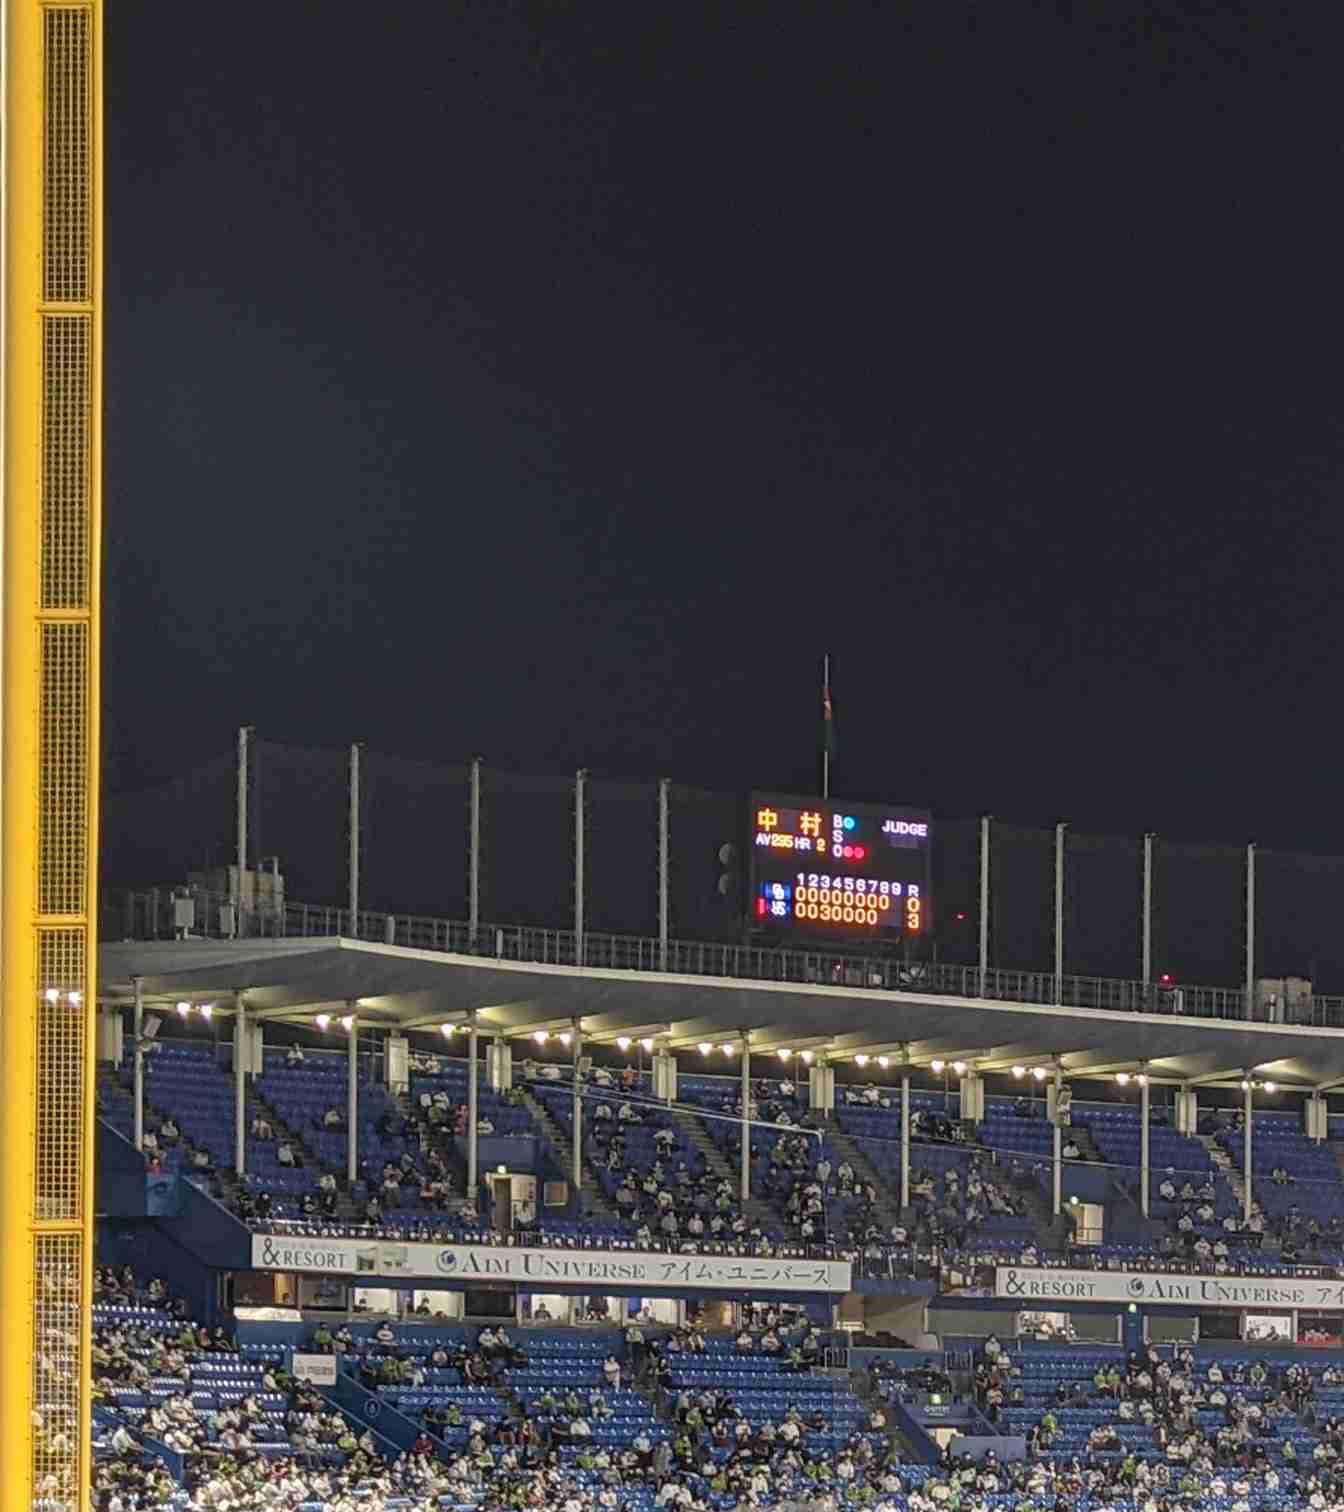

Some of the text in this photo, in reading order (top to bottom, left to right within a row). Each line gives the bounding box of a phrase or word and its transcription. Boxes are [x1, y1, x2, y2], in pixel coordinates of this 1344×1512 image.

[833, 814, 842, 828] B
[882, 820, 927, 836] JUDGE
[832, 830, 843, 843] S
[908, 884, 919, 897] R
[908, 914, 919, 929] 3
